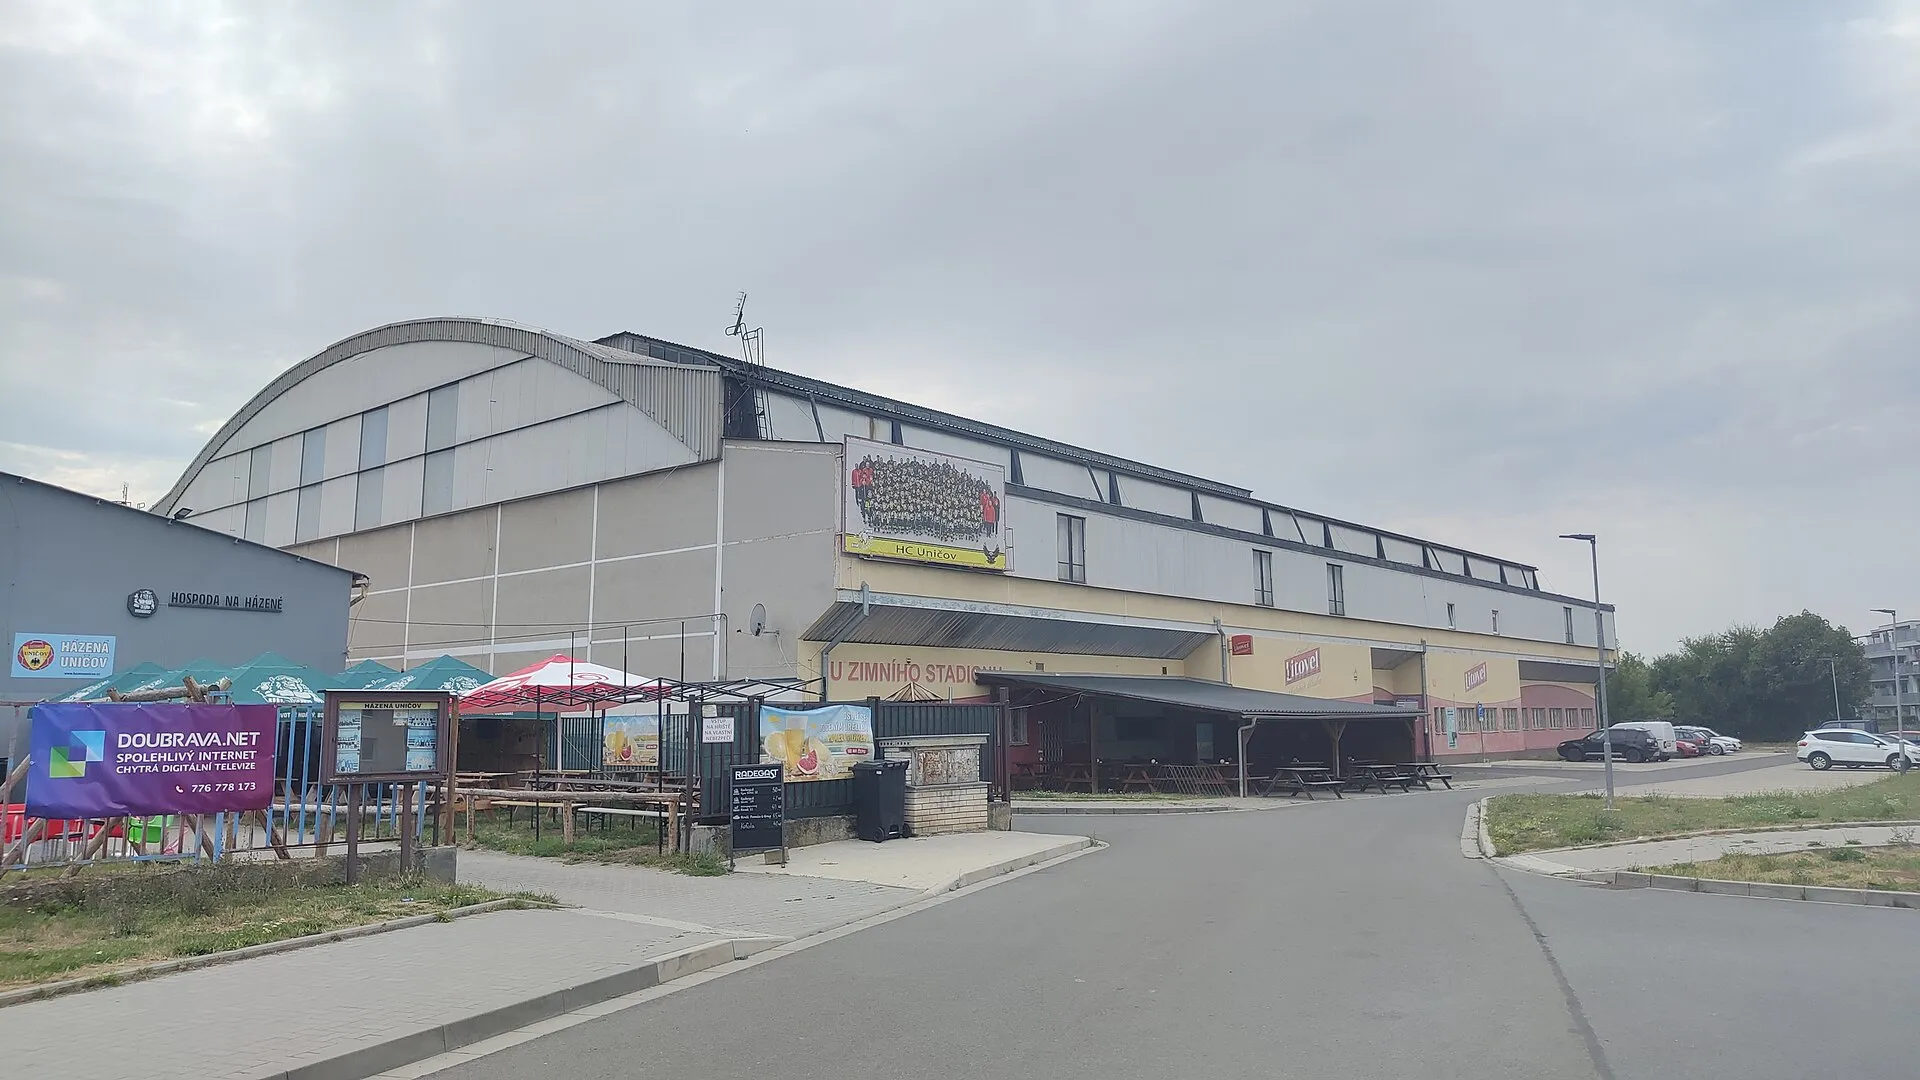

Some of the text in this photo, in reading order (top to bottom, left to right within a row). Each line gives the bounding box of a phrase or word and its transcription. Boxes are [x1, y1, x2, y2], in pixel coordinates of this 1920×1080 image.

[896, 545, 957, 560] HC Uničov
[171, 592, 283, 610] HOSPODA NA HÁZENÉ
[830, 661, 842, 681] U
[848, 659, 921, 683] ZIMNÍHO
[1286, 651, 1319, 682] Litovel
[118, 732, 260, 748] DOUBRAVA.NET
[116, 750, 257, 763] SPOLEHLIVÝ INTERNET
[116, 762, 256, 774] CHYTRÁ DIGITÁLNÍ TELEVIZE
[735, 769, 779, 780] RADEGAST
[191, 782, 256, 793] 776 778 173
